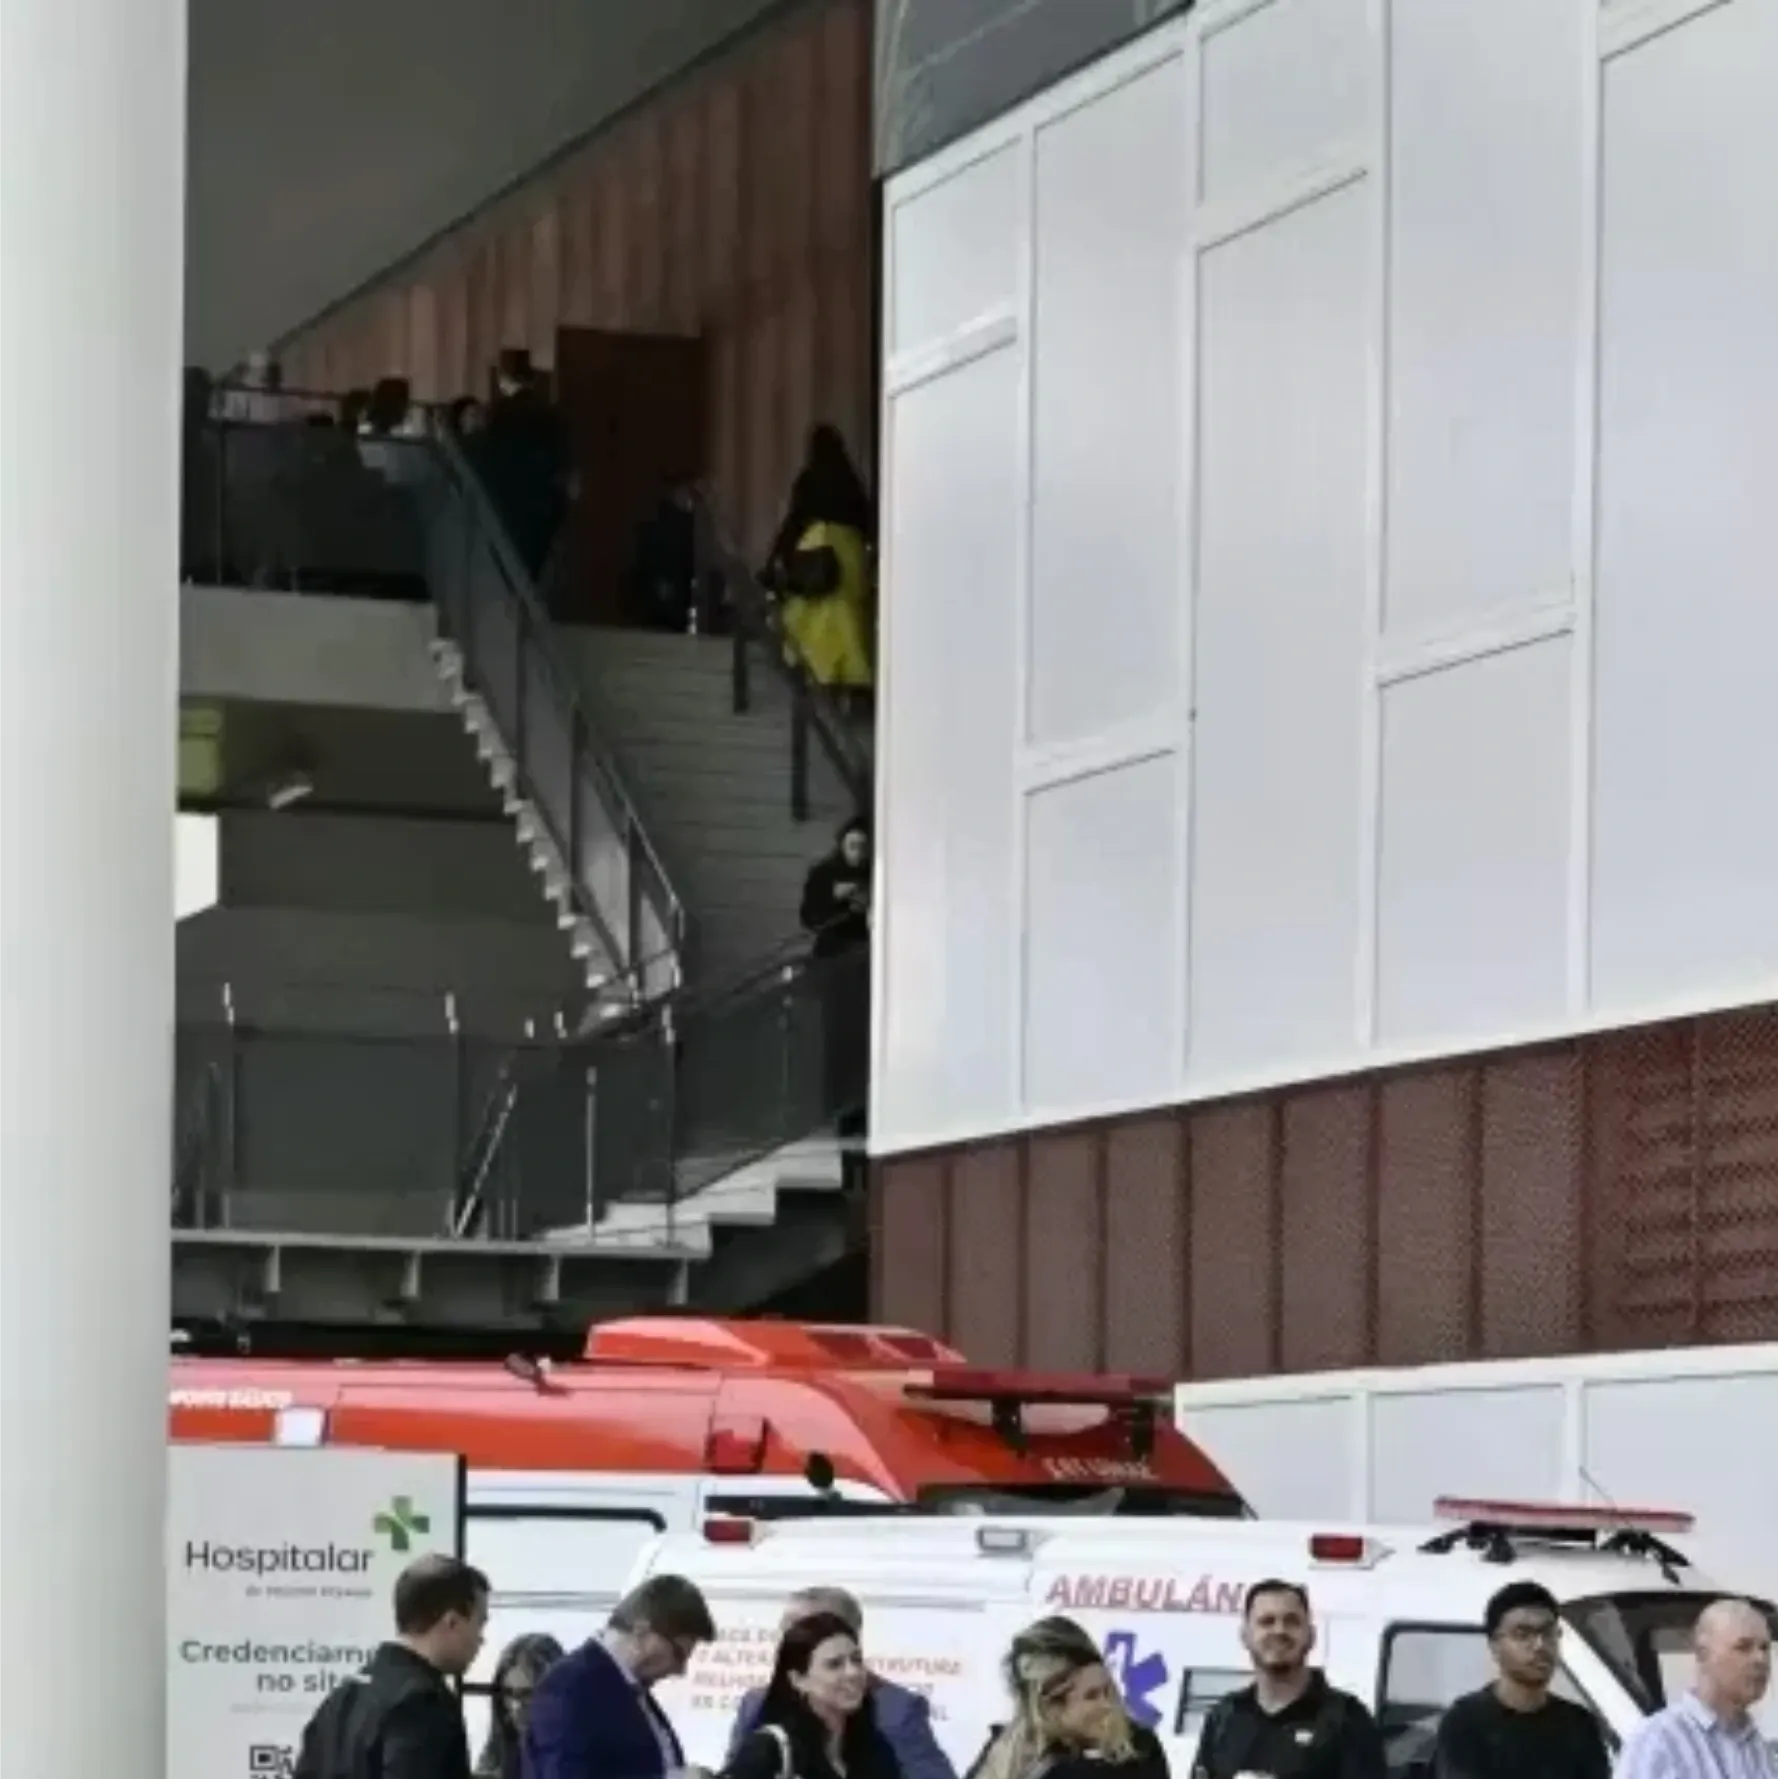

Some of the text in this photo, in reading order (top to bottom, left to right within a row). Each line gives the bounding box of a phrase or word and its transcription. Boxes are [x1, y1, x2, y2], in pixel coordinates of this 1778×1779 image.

[186, 1541, 374, 1577] Hospitalar
[181, 1640, 371, 1664] Credenciam
[257, 1669, 340, 1692] no sit
